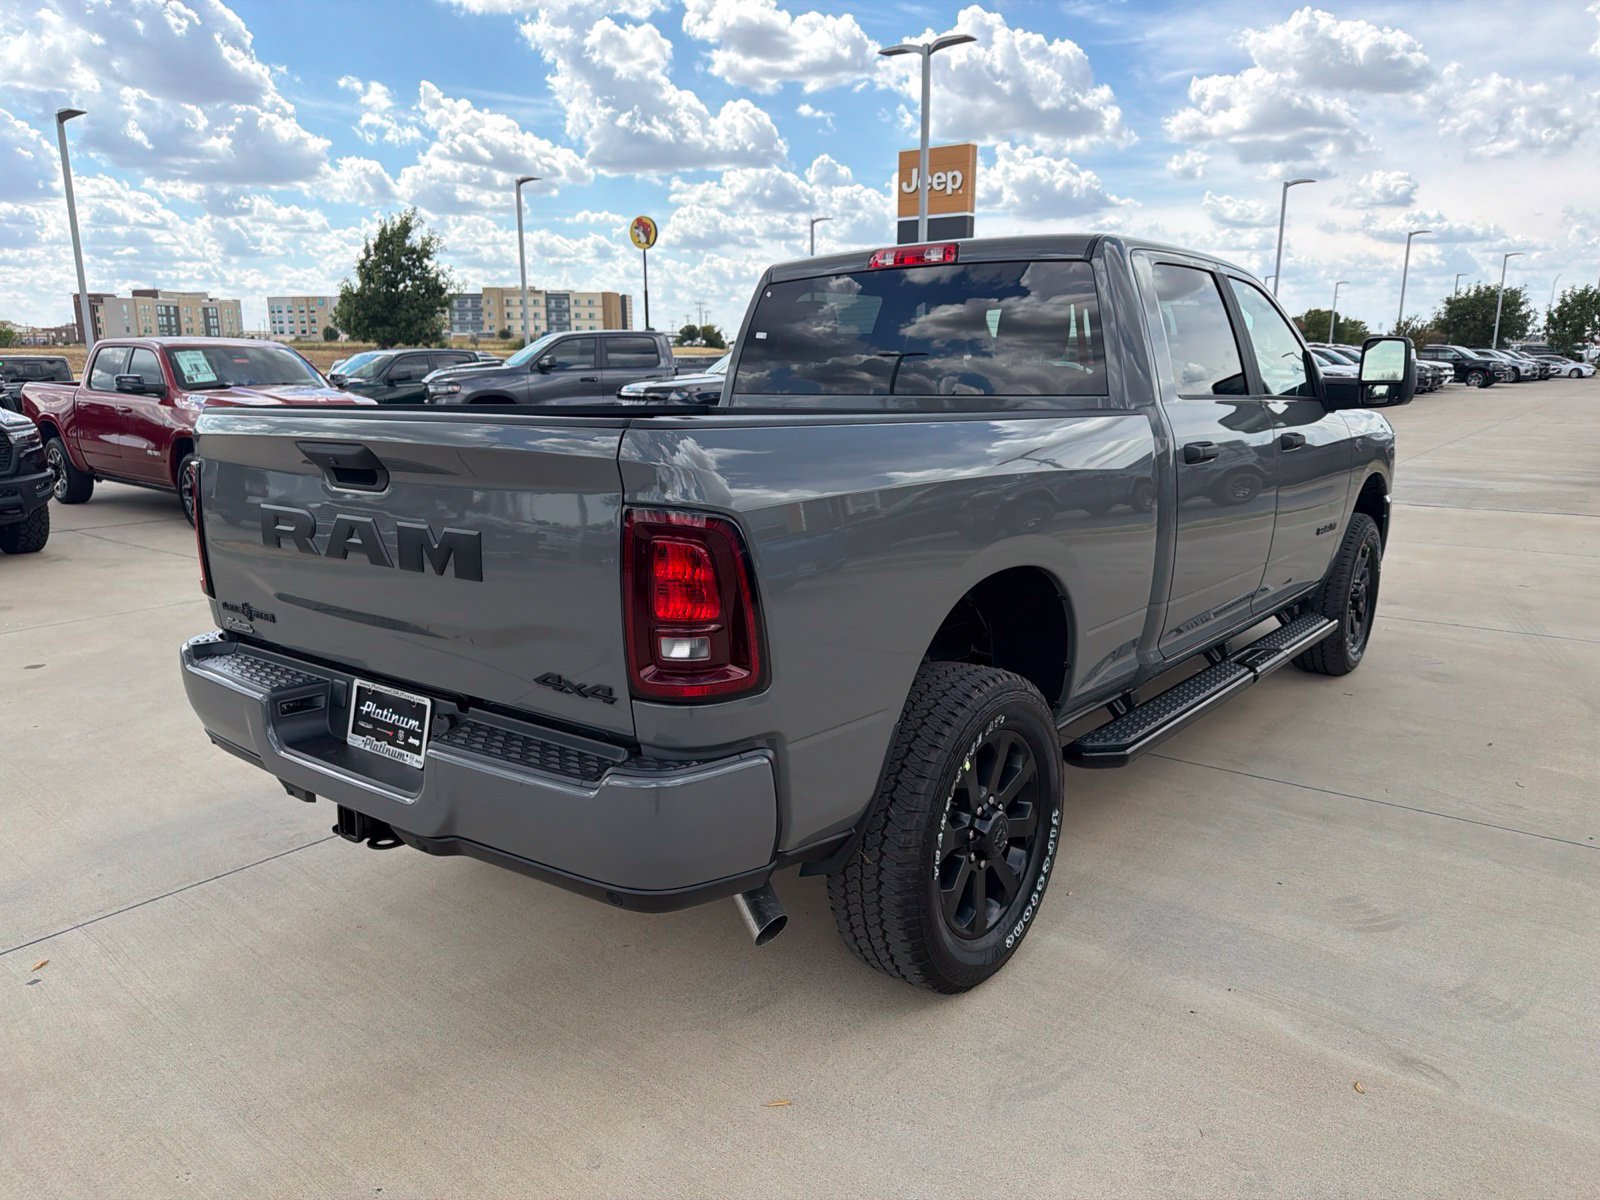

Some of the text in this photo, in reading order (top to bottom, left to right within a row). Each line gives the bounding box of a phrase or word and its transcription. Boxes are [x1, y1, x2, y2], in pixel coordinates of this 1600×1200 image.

[260, 503, 483, 582] RAM
[360, 701, 422, 732] Platinum
[364, 736, 408, 762] Platinum
